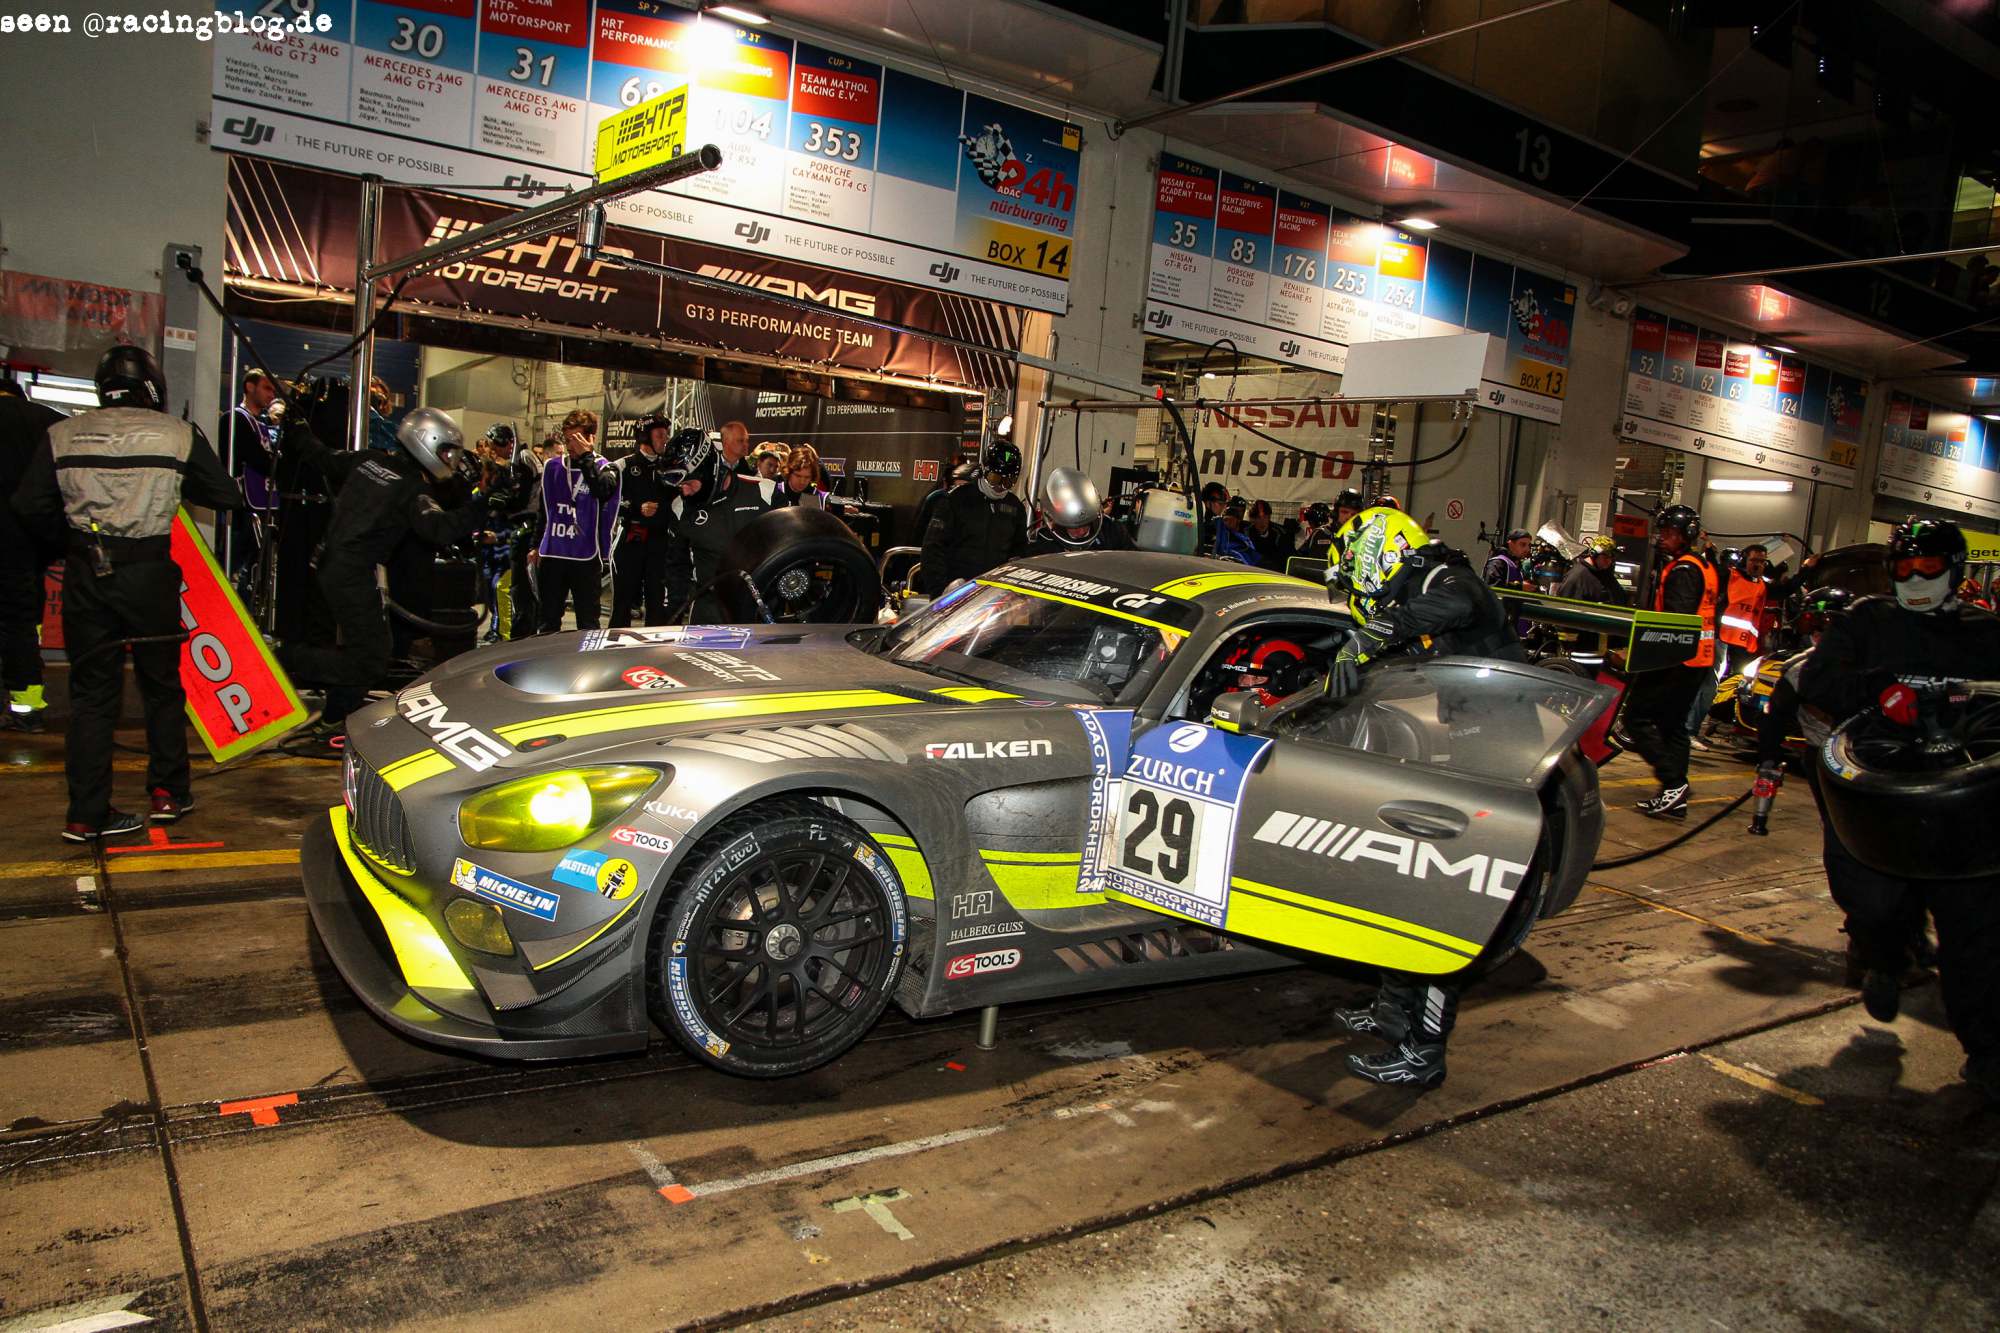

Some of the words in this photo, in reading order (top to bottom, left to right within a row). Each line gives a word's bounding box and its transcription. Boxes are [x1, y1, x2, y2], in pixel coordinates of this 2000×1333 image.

[489, 11, 572, 34] MOTORSPORT
[601, 17, 624, 30] HRT
[390, 16, 444, 59] 30
[251, 41, 284, 57] AMG
[288, 50, 317, 64] GT3
[309, 42, 341, 57] AMG
[363, 55, 432, 79] MERCEDES
[434, 72, 463, 86] AMG
[510, 47, 556, 87] 31
[383, 72, 412, 87] AMG
[417, 80, 443, 94] GT3
[800, 83, 836, 98] RACING
[838, 89, 859, 101] E.V.
[801, 72, 828, 85] TEAM
[830, 78, 869, 93] MATHOL
[486, 83, 548, 106] MERCEDES
[551, 100, 577, 113] AMG
[503, 100, 530, 114] AMG
[534, 107, 559, 120] GT3
[612, 131, 680, 167] MOTORSPORT
[804, 121, 862, 162] 353
[1514, 126, 1552, 181] 13
[792, 167, 832, 184] CAYMAN
[834, 177, 854, 189] GT4
[856, 182, 868, 192] CS
[810, 160, 853, 178] PORSCHE
[996, 184, 1023, 200] ADAC
[1001, 159, 1075, 213] 24h
[1160, 176, 1185, 188] NISSAN
[1185, 181, 1196, 190] GT
[1160, 186, 1193, 198] ACADEMY
[1195, 191, 1213, 202] TEAM
[1160, 194, 1174, 204] RJN
[1222, 195, 1264, 210] RENT2DRIVE-
[1222, 204, 1245, 215] RACING
[295, 135, 321, 149] THE
[324, 139, 374, 161] FUTURE
[376, 151, 395, 164] OF
[398, 154, 455, 177] POSSIBLE
[629, 202, 645, 213] OF
[647, 205, 695, 225] POSSIBLE
[784, 234, 802, 246] THE
[804, 237, 838, 254] FUTURE
[841, 246, 853, 257] OF
[855, 248, 896, 266] POSSIBLE
[970, 273, 987, 285] THE
[988, 277, 1017, 292] FUTURE
[1018, 283, 1030, 294] OF
[1031, 285, 1066, 303] POSSIBLE
[989, 200, 1069, 232] nürburgring
[1279, 213, 1318, 227] RENT2DRIVE-
[1279, 221, 1301, 232] RACING
[1169, 221, 1199, 248] 35
[986, 240, 1026, 266] BOX
[1036, 238, 1069, 274] 14
[1170, 251, 1193, 264] NISSAN
[1230, 238, 1256, 264] 83
[1226, 265, 1256, 280] PORSCHE
[1283, 253, 1317, 281] 176
[1226, 274, 1241, 285] GT3
[1241, 277, 1254, 288] CUP
[1283, 282, 1311, 294] RENAULT
[1333, 267, 1368, 296] 253
[1279, 289, 1304, 302] MEGANE
[1382, 282, 1416, 311] 254
[685, 303, 716, 322] GT3
[720, 310, 832, 342] PERFORMANCE
[836, 328, 874, 348] TEAM
[1181, 320, 1193, 331] THE
[1196, 323, 1218, 336] FUTURE
[1219, 327, 1228, 337] OF
[1229, 330, 1257, 344] POSSIBLE
[1308, 349, 1318, 359] THE
[1319, 352, 1338, 363] FUTURE
[1639, 355, 1655, 375] 52
[1671, 364, 1685, 384] 53
[1520, 371, 1541, 390] BOX
[1544, 370, 1564, 394] 13
[1700, 373, 1714, 393] 62
[1729, 381, 1744, 401] 63
[755, 406, 807, 418] MOTORSPORT
[826, 405, 836, 415] GT3
[836, 405, 879, 415] PERFORMANCE
[1203, 396, 1361, 428] NISSAN
[1780, 397, 1799, 416] 124
[691, 440, 711, 467] uvex
[1199, 448, 1355, 480] nismo
[856, 460, 882, 472] HALBERG
[882, 461, 901, 472] GUSS
[551, 522, 577, 539] 104
[1045, 586, 1090, 601] SIMULATOR
[1655, 632, 1695, 644] AMG
[397, 690, 513, 772] AMG
[1078, 710, 1105, 758] ADAC
[925, 739, 1053, 760] FALKEN
[1127, 754, 1216, 796] ZURICH
[642, 800, 700, 823] KUKA
[1082, 764, 1107, 877] NORDRHEIN
[611, 827, 635, 844] KS
[635, 833, 669, 851] TOOLS
[809, 824, 828, 841] FL
[1122, 788, 1196, 885] 29
[559, 859, 598, 878] BILSTEIN
[477, 875, 557, 912] MICHELIN
[876, 864, 905, 937] MICHELIN
[952, 890, 994, 919] HA
[1104, 880, 1222, 927] NORDSCHLEIFE
[1107, 870, 1223, 918] NÜRBURGRING
[950, 922, 997, 941] HALBERG
[997, 920, 1025, 934] GUSS
[949, 956, 977, 977] KS
[975, 951, 1018, 969] TOOLS
[670, 960, 707, 1041] MICHELIN
